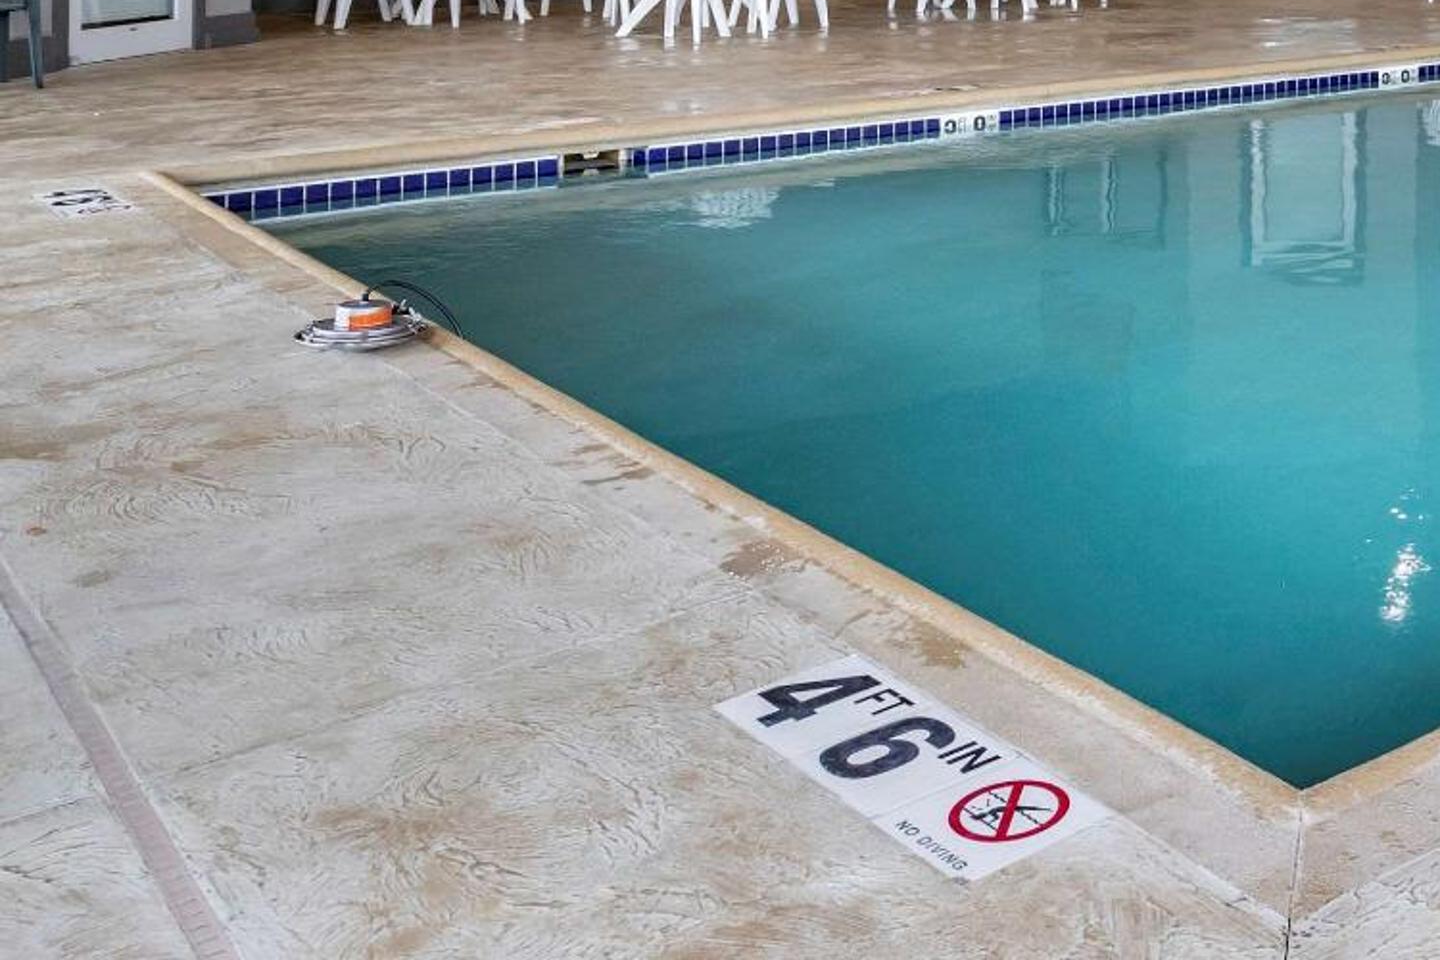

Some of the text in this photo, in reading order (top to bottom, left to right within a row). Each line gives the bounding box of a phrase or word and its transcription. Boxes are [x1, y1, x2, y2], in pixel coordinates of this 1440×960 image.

[756, 674, 1002, 780] 4 FT 6 IN
[895, 819, 969, 872] NO DIVING
